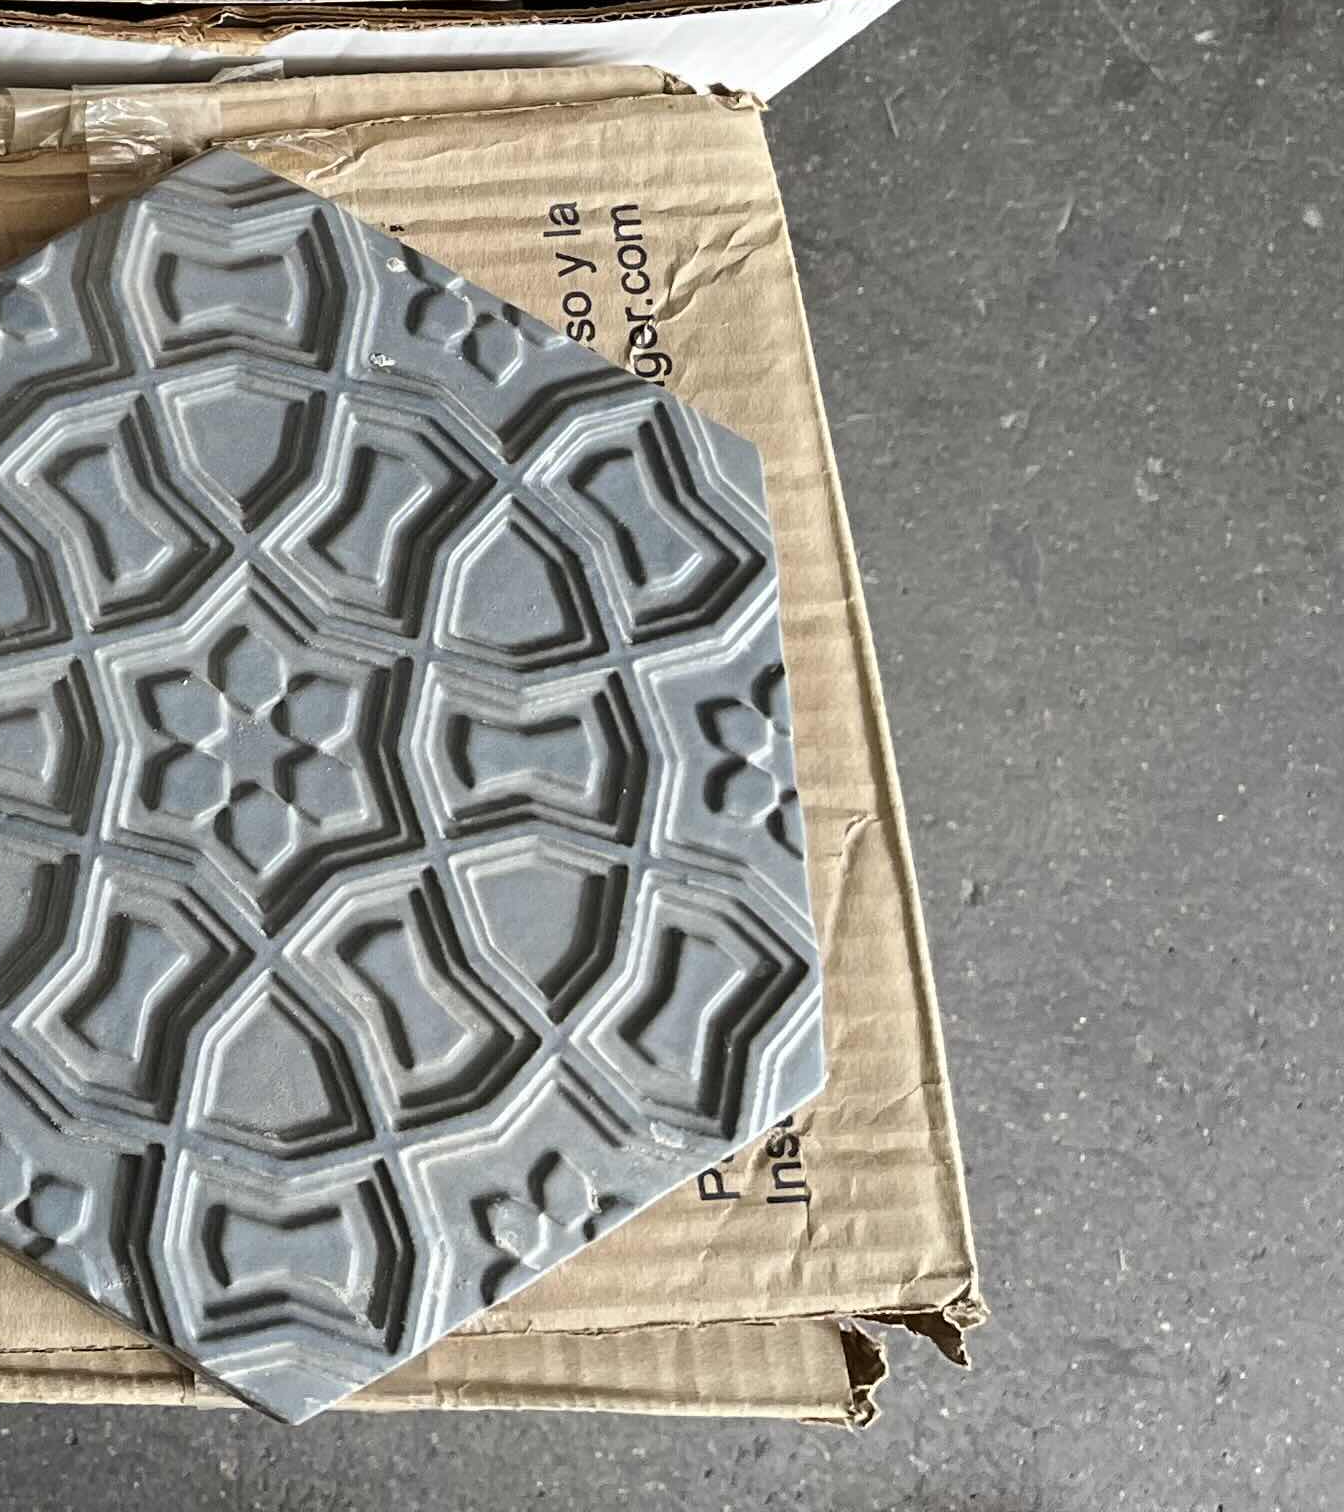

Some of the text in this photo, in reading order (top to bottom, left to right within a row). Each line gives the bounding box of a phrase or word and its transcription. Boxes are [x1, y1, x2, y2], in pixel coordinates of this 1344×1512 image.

[543, 201, 597, 353] so y la
[610, 203, 673, 386] ger.com
[765, 1114, 812, 1204] Ins
